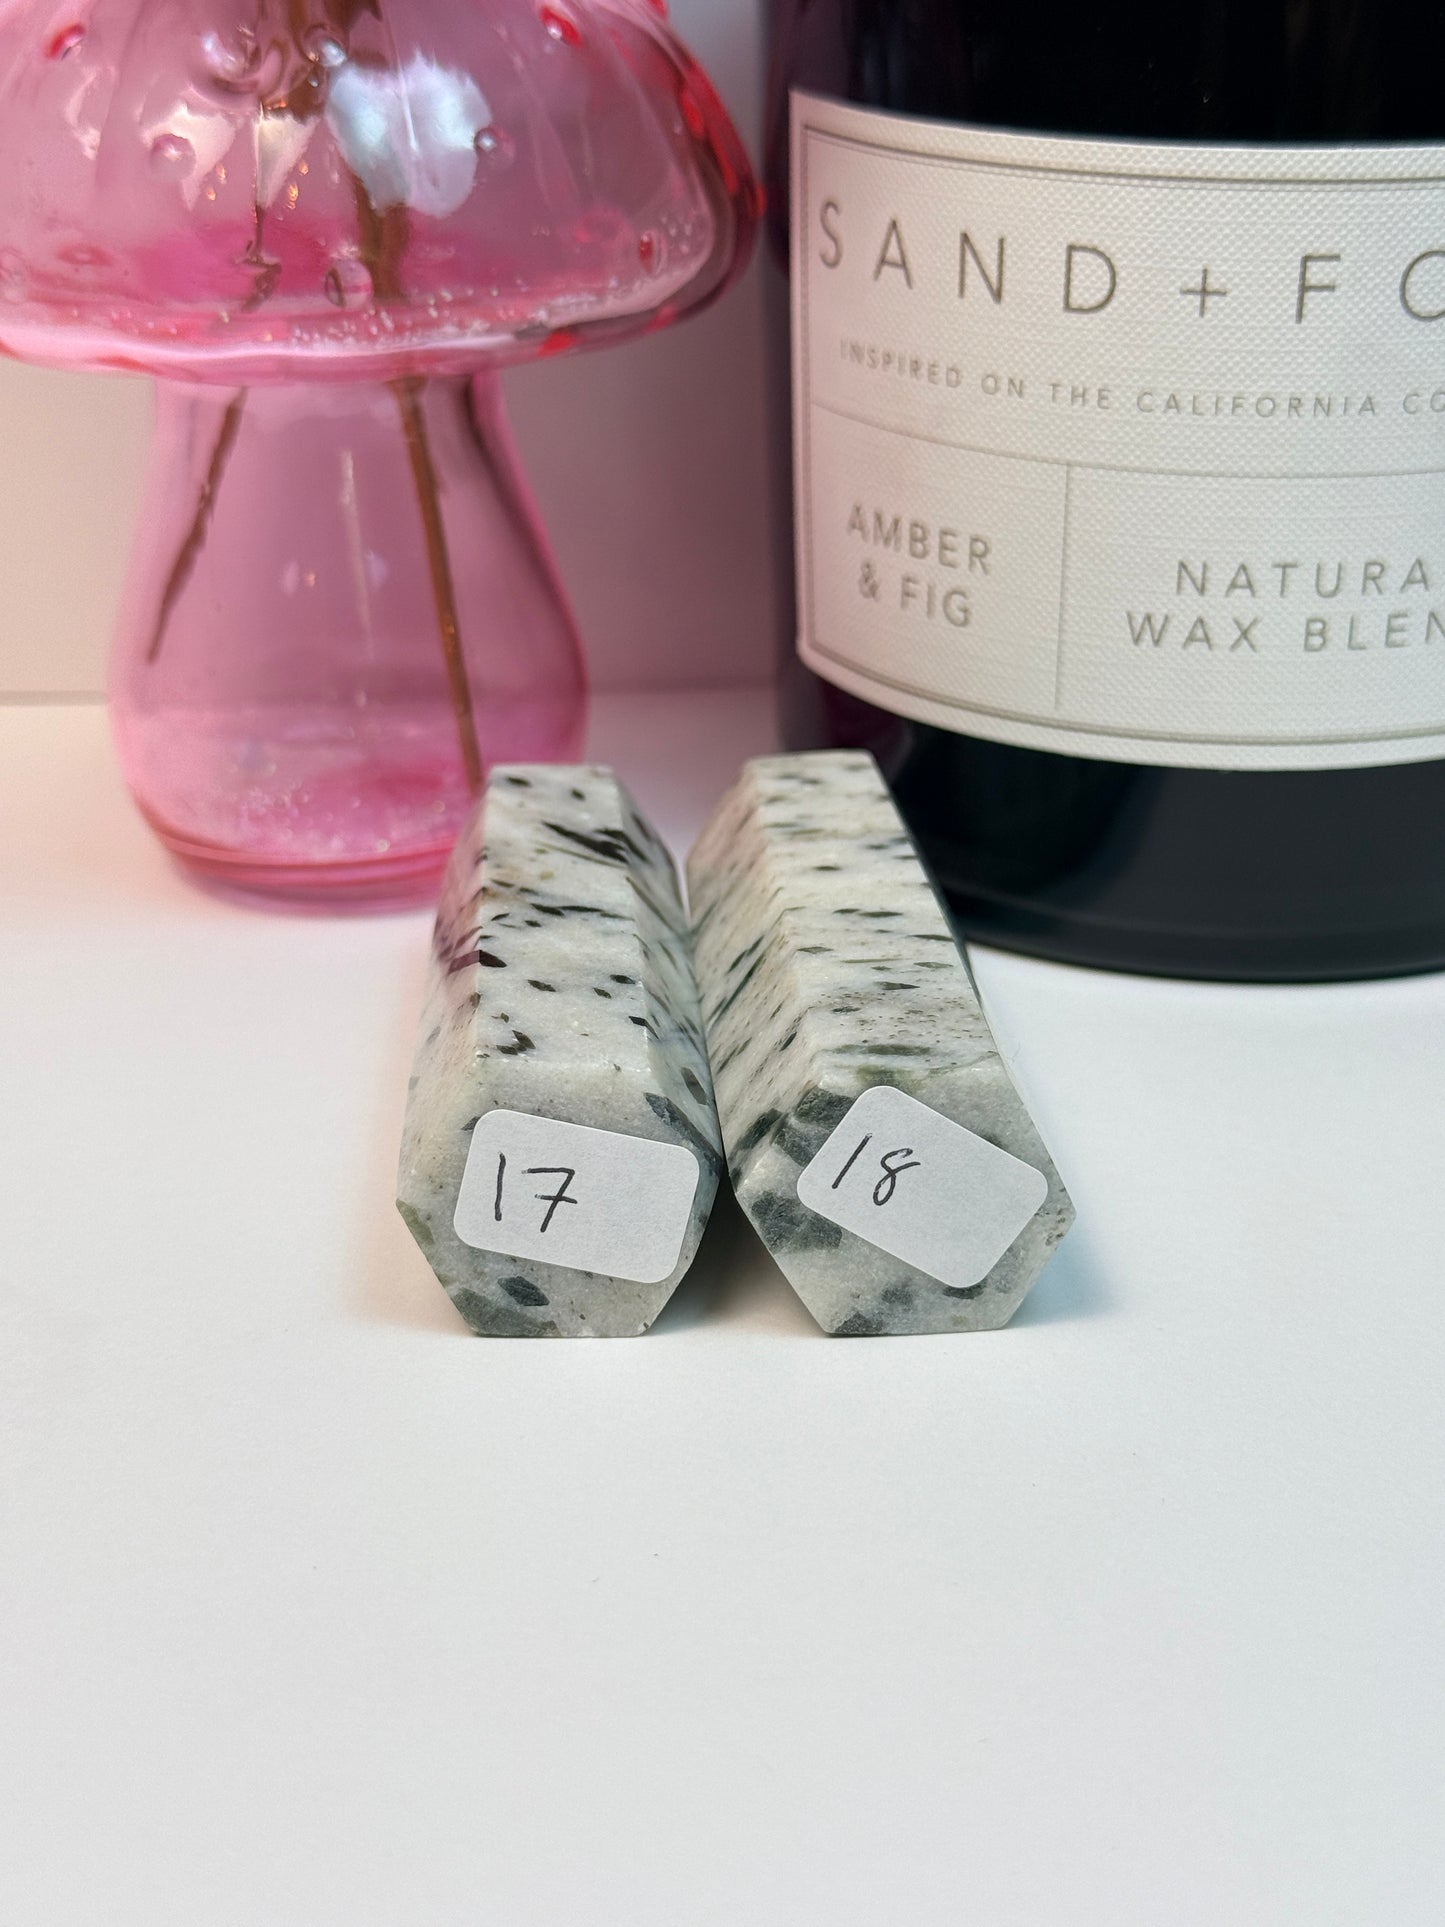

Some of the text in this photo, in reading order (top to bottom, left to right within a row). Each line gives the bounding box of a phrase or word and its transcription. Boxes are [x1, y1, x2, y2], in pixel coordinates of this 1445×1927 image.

[818, 199, 1117, 315] SAND
[1179, 267, 1228, 319] +
[840, 339, 963, 389] INSPIRED
[980, 373, 1024, 399] ON
[1049, 382, 1111, 410] THE
[1135, 391, 1378, 418] CALIFORNIA
[847, 503, 991, 575] AMBER
[859, 559, 972, 628] & FIG
[1175, 556, 1430, 600] NATURA
[1126, 609, 1445, 653] WAX BLEN
[493, 1153, 580, 1233] 17
[830, 1133, 921, 1206] 18
